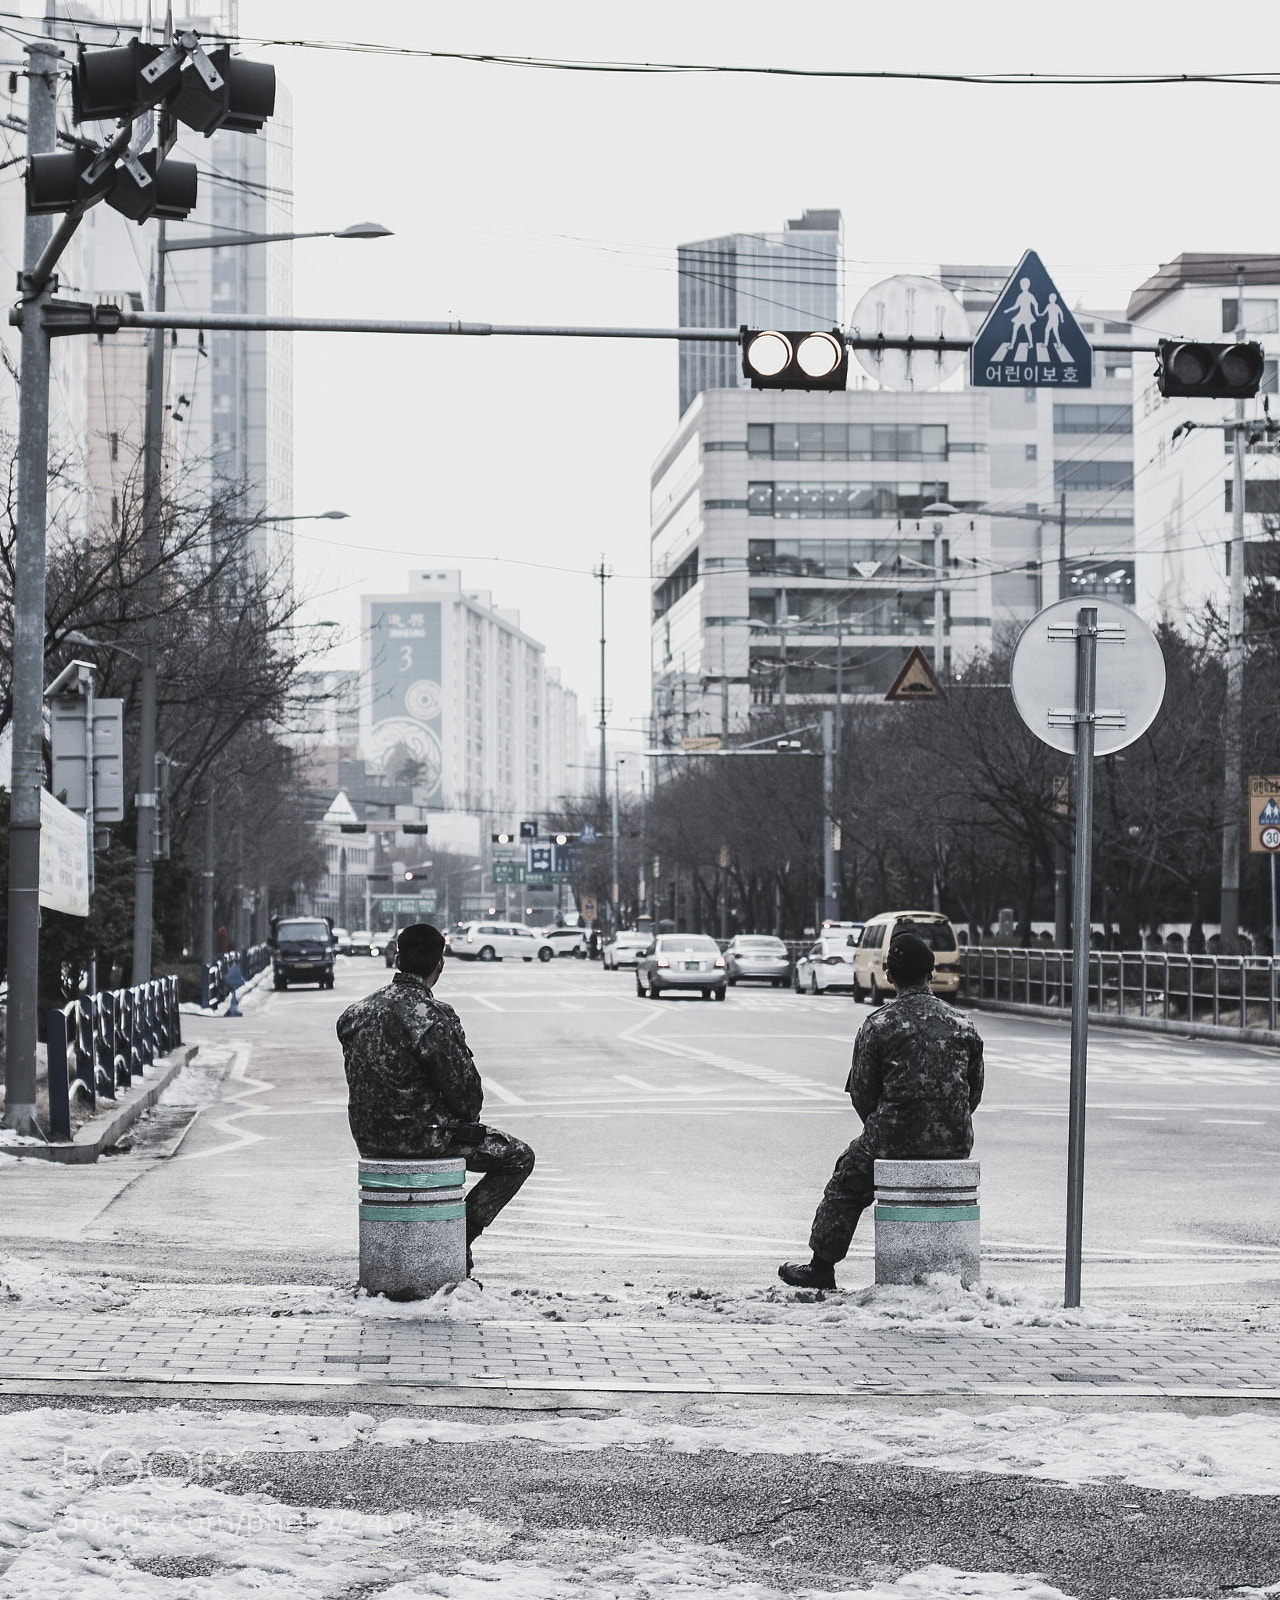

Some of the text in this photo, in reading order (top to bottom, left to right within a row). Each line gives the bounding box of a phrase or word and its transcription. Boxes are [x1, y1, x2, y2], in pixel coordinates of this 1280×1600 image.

[985, 365, 1079, 383] 어린이보호
[398, 645, 413, 672] 3
[1266, 831, 1279, 844] 30
